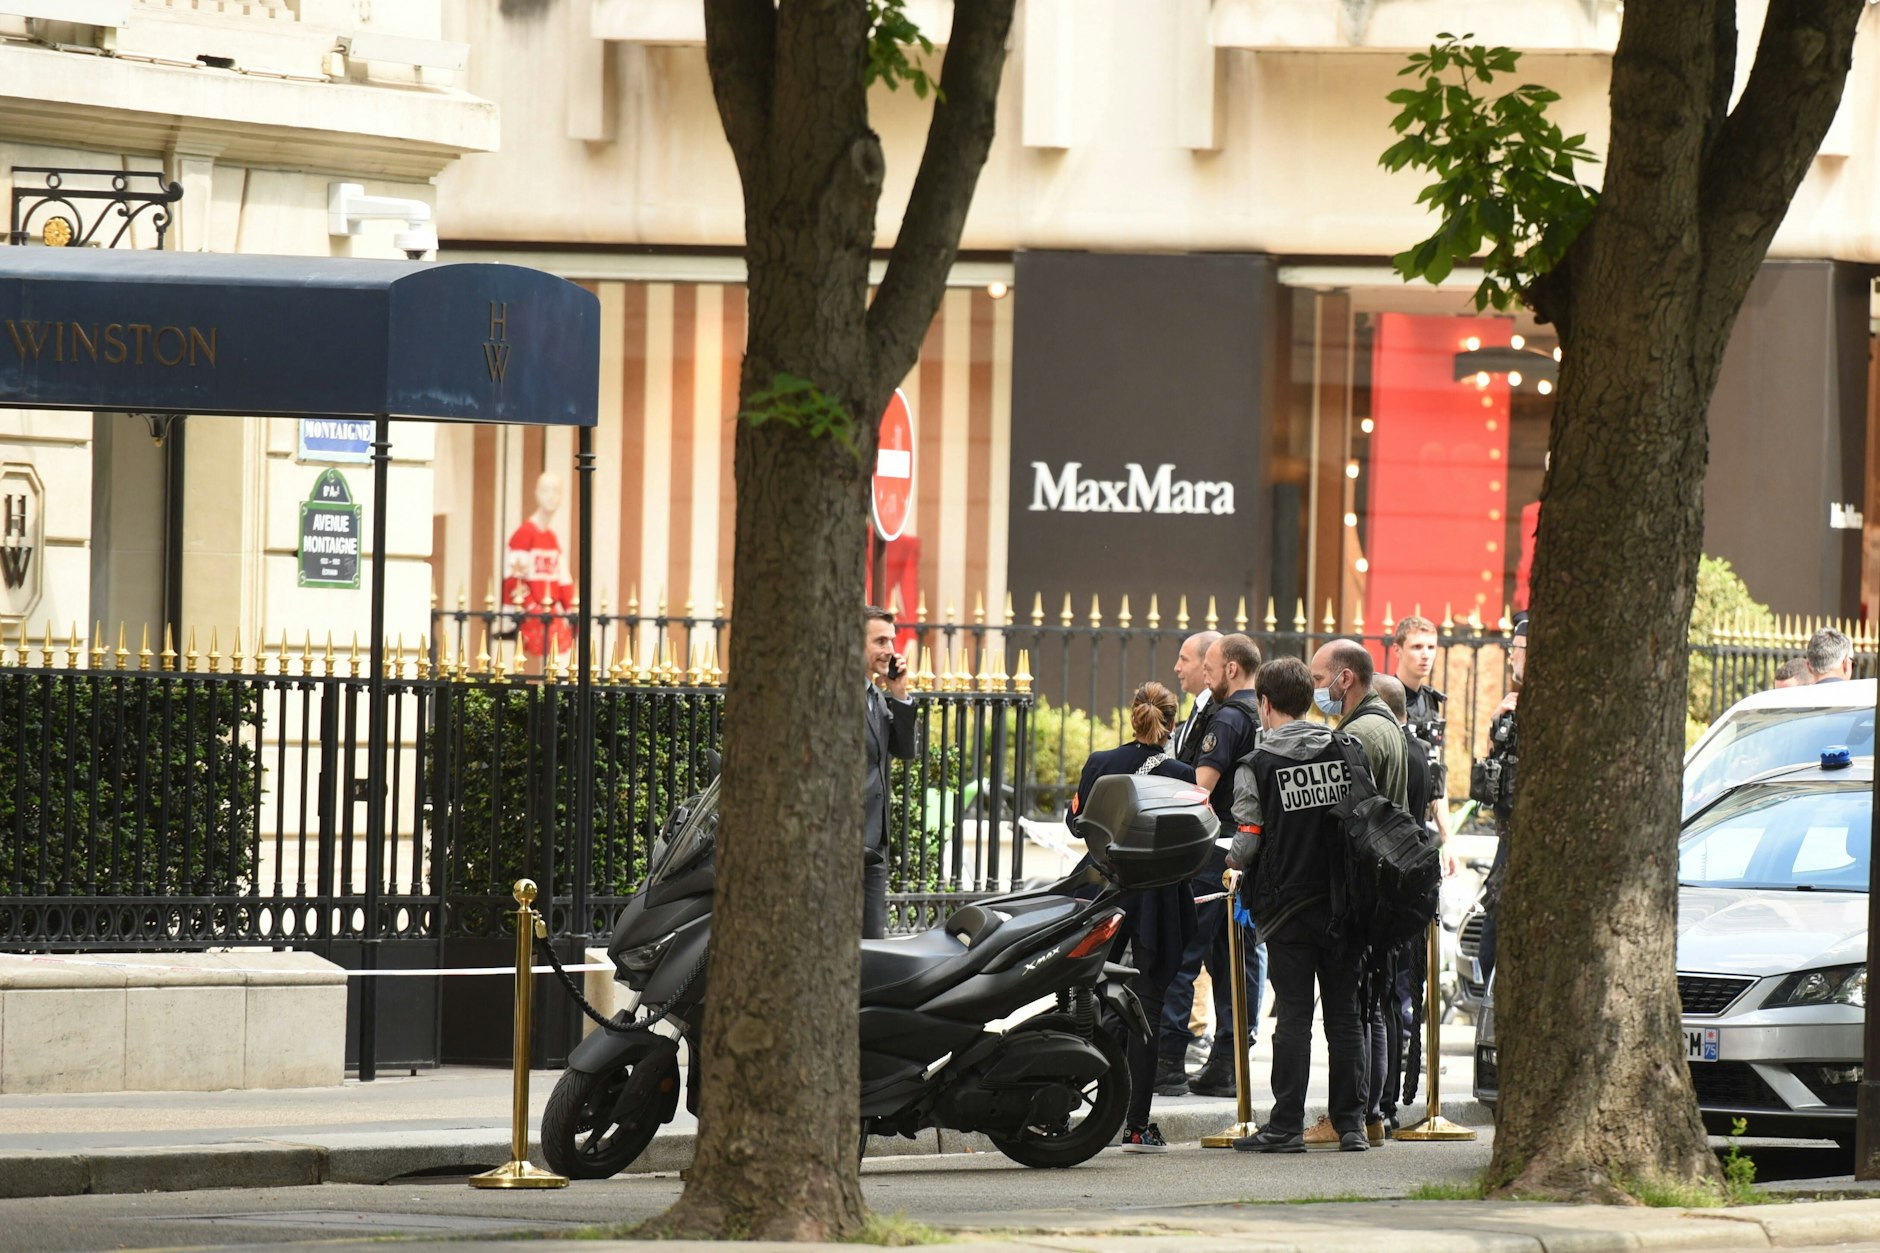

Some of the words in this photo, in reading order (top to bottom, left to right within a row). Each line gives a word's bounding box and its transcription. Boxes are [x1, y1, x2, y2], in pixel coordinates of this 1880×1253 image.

[488, 300, 507, 341] H
[5, 319, 218, 368] WINSTON
[482, 343, 512, 383] W
[305, 420, 371, 442] MONTAIGNE
[1028, 461, 1236, 515] MaxMara
[5, 494, 27, 537] H
[312, 513, 350, 532] AVENUE
[303, 535, 357, 555] MONTAIGNE
[1277, 762, 1352, 791] POLICE
[1705, 1043, 1717, 1056] 75
